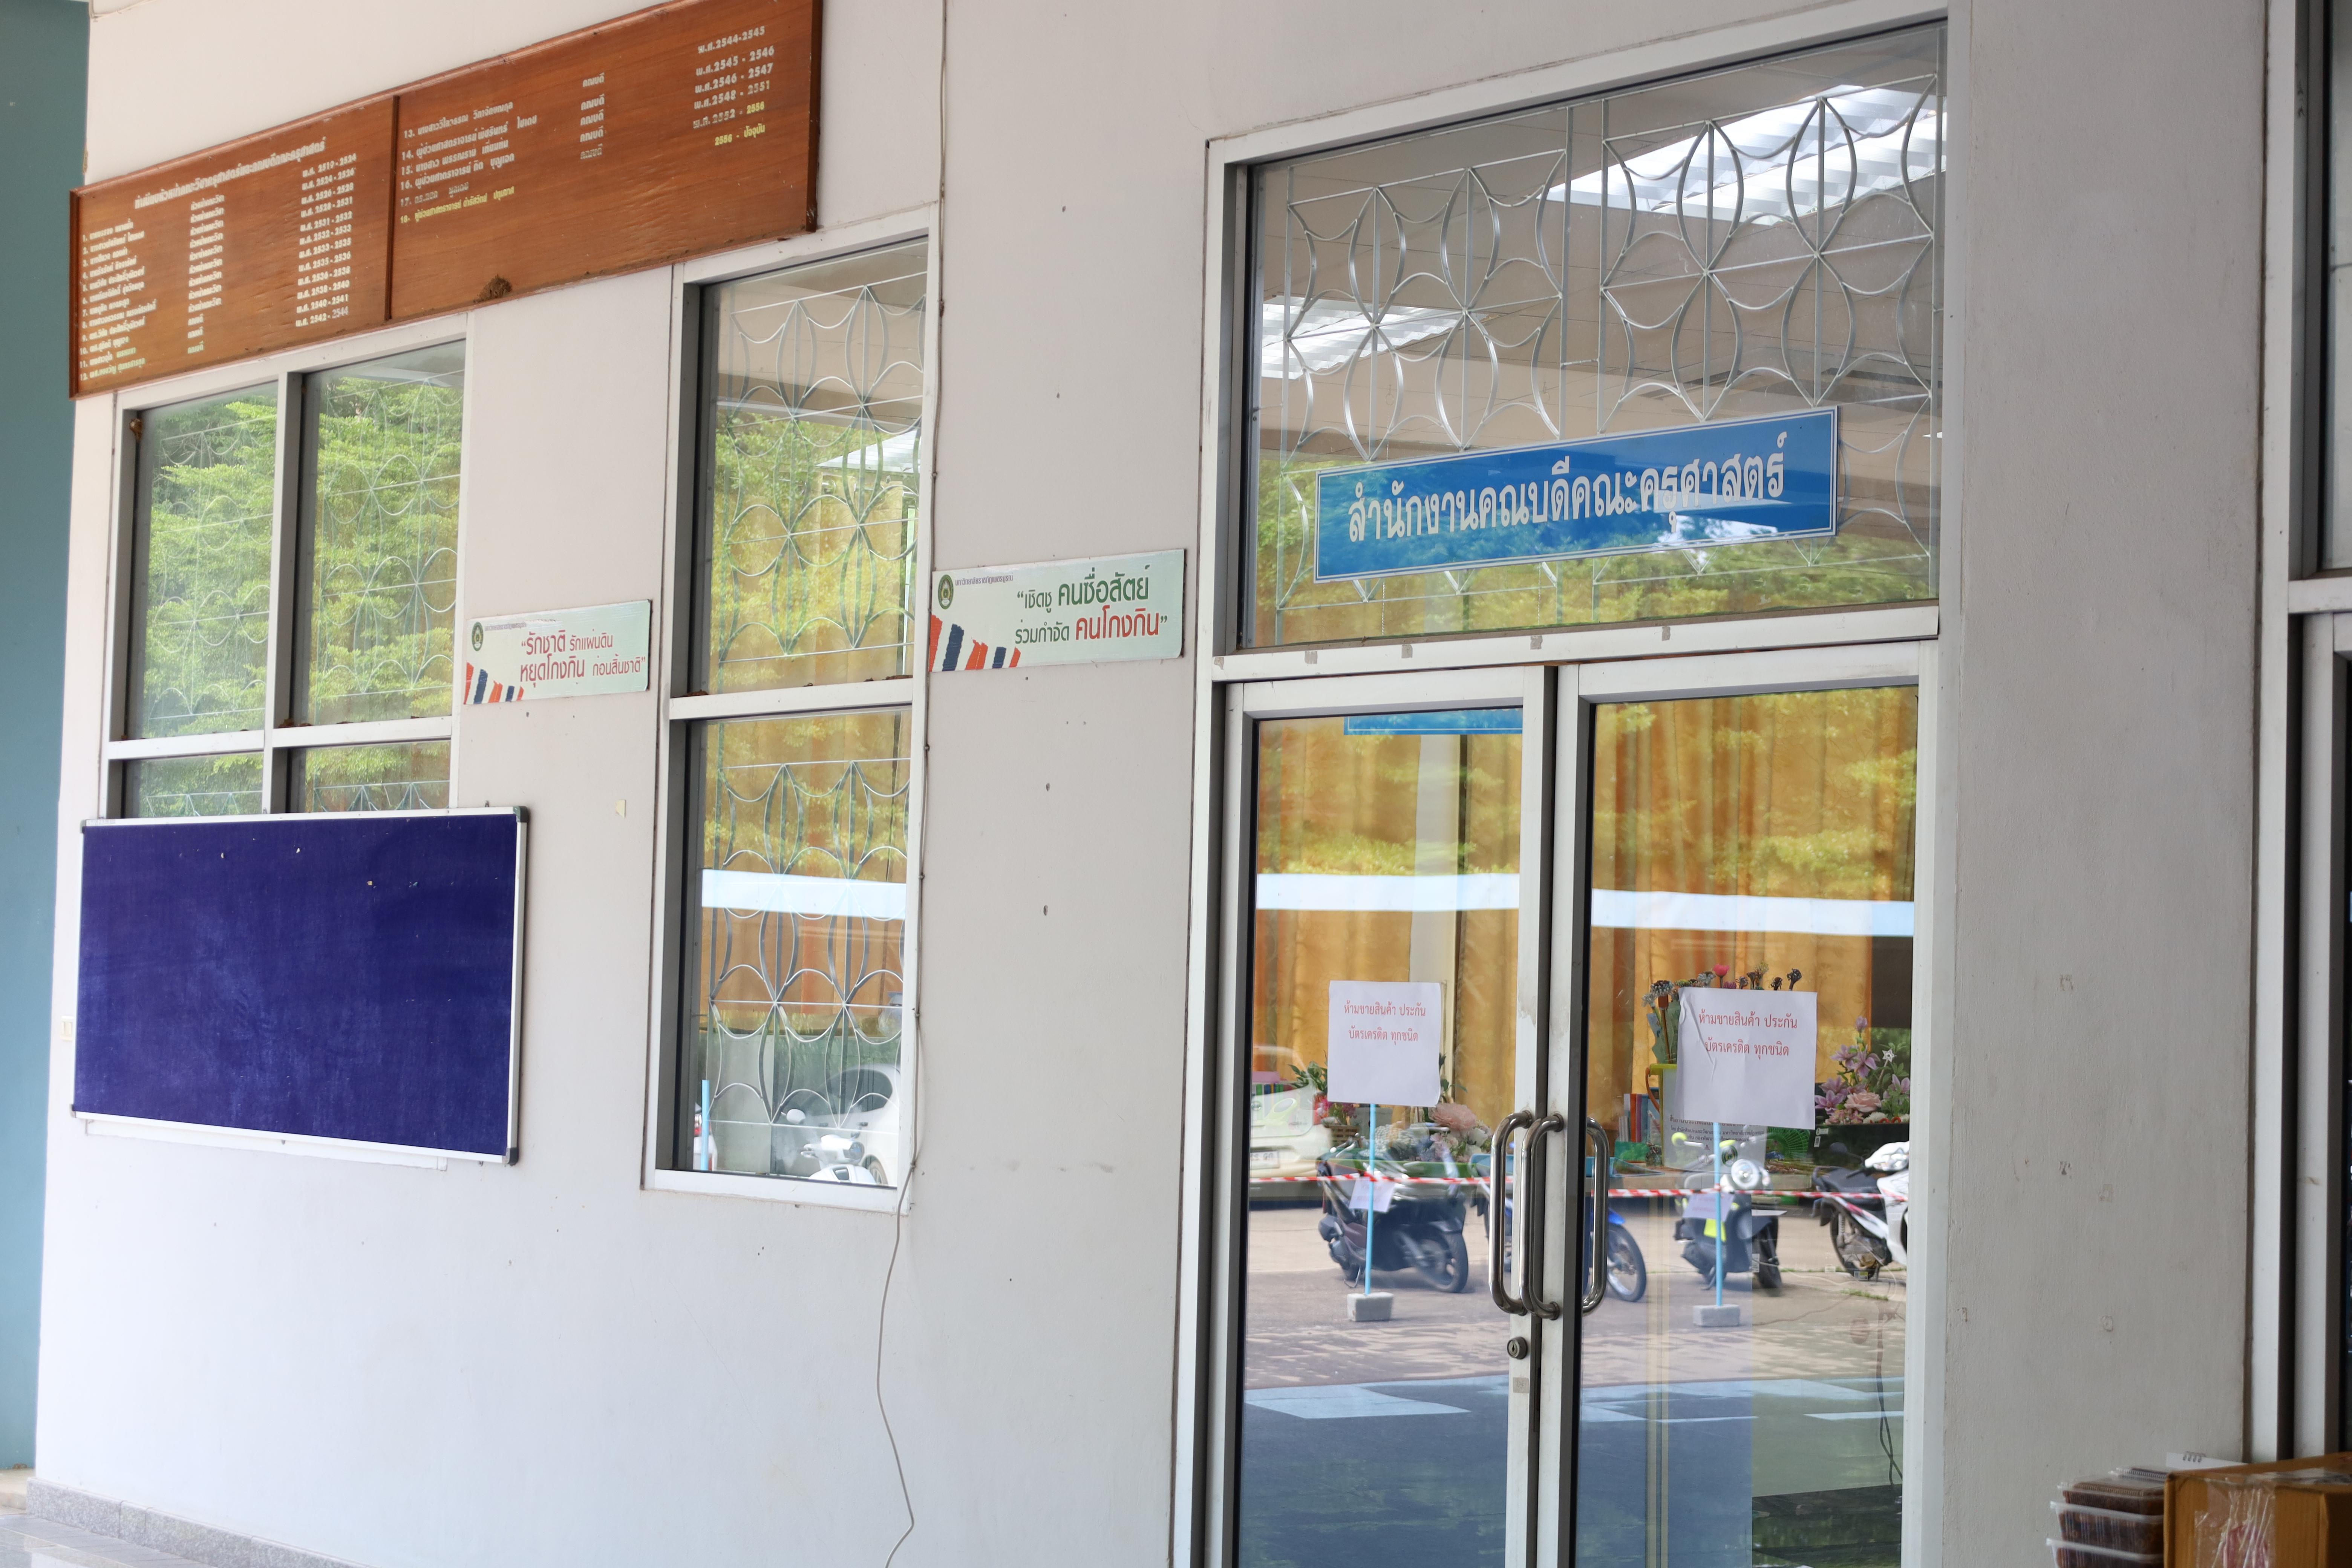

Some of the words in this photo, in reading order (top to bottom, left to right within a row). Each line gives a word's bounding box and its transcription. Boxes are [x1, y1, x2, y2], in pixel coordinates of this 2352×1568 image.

[404, 129, 415, 139] 13.
[402, 150, 414, 160] 14.
[401, 165, 413, 176] 15.
[401, 181, 412, 190] 16.
[188, 314, 203, 325] คณบดี
[188, 326, 203, 338] คณบดี
[188, 341, 203, 354] คณบดี
[1348, 431, 1788, 542] สำนักงานคณบดีคณะครุศาสตร์
[1058, 565, 1150, 606] คนซื่อสัตย์
[570, 629, 613, 651] รักแผ่นดิน
[1015, 619, 1069, 645] ร่วมกำจัด
[521, 653, 585, 688] หยุดโกงกิน
[1344, 999, 1396, 1016] ห้ามขายสินค้า
[1399, 1002, 1426, 1017] ประกัน
[1698, 1008, 1760, 1027] ห้ามขายสินค้า
[1764, 1013, 1798, 1029] ประกัน
[1348, 1025, 1387, 1040] บัตรเครดิต
[1390, 1027, 1418, 1046] ทุกชนิด
[1705, 1036, 1749, 1054] บัตรเครดิต
[1754, 1041, 1789, 1060] ทุกชนิด
